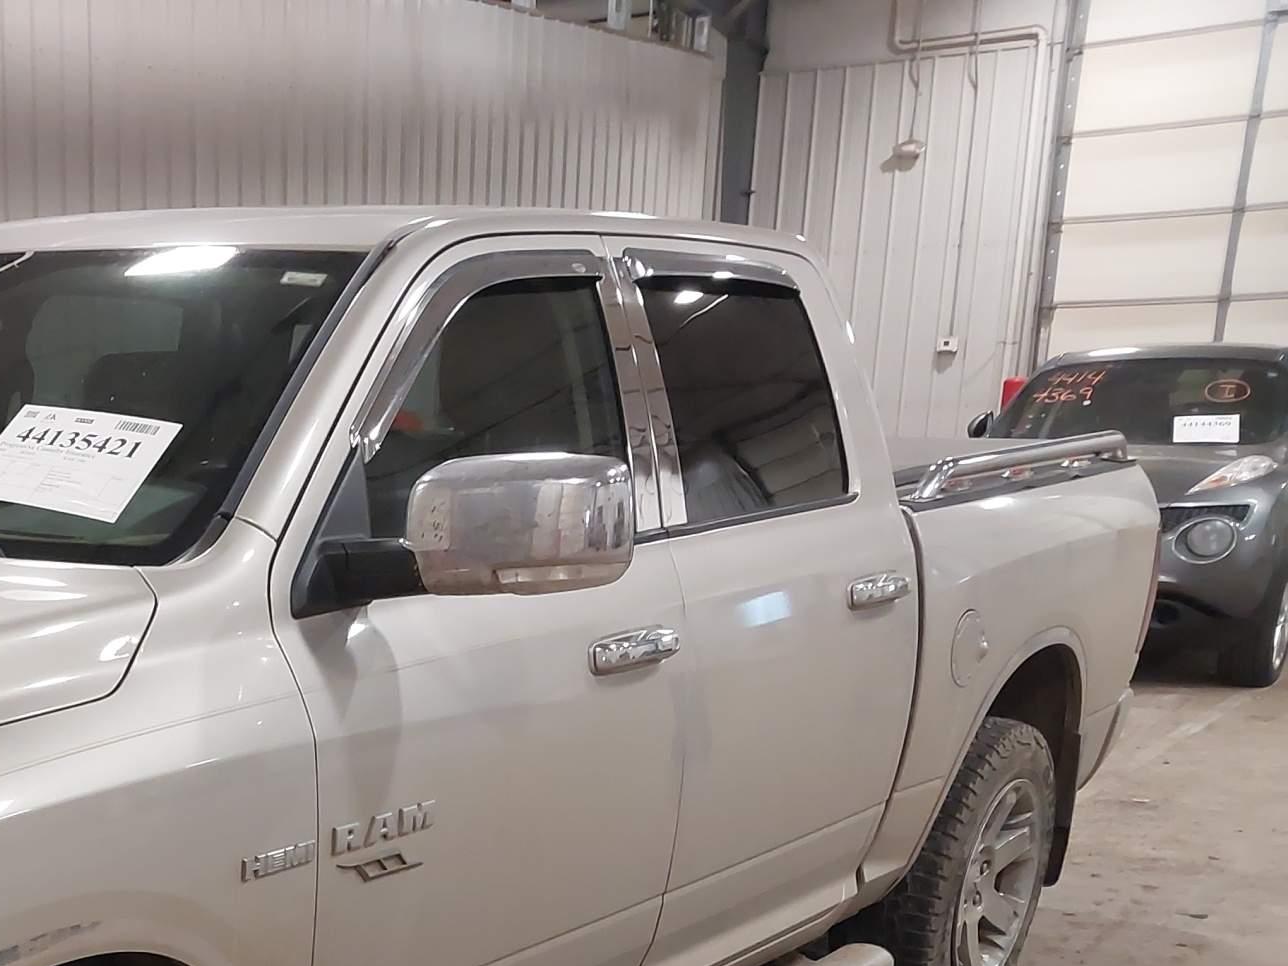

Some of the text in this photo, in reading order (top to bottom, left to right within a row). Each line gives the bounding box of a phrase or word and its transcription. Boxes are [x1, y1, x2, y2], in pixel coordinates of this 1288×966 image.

[16, 426, 142, 459] 44135421
[331, 800, 436, 857] RAM
[241, 840, 316, 883] HEMI
